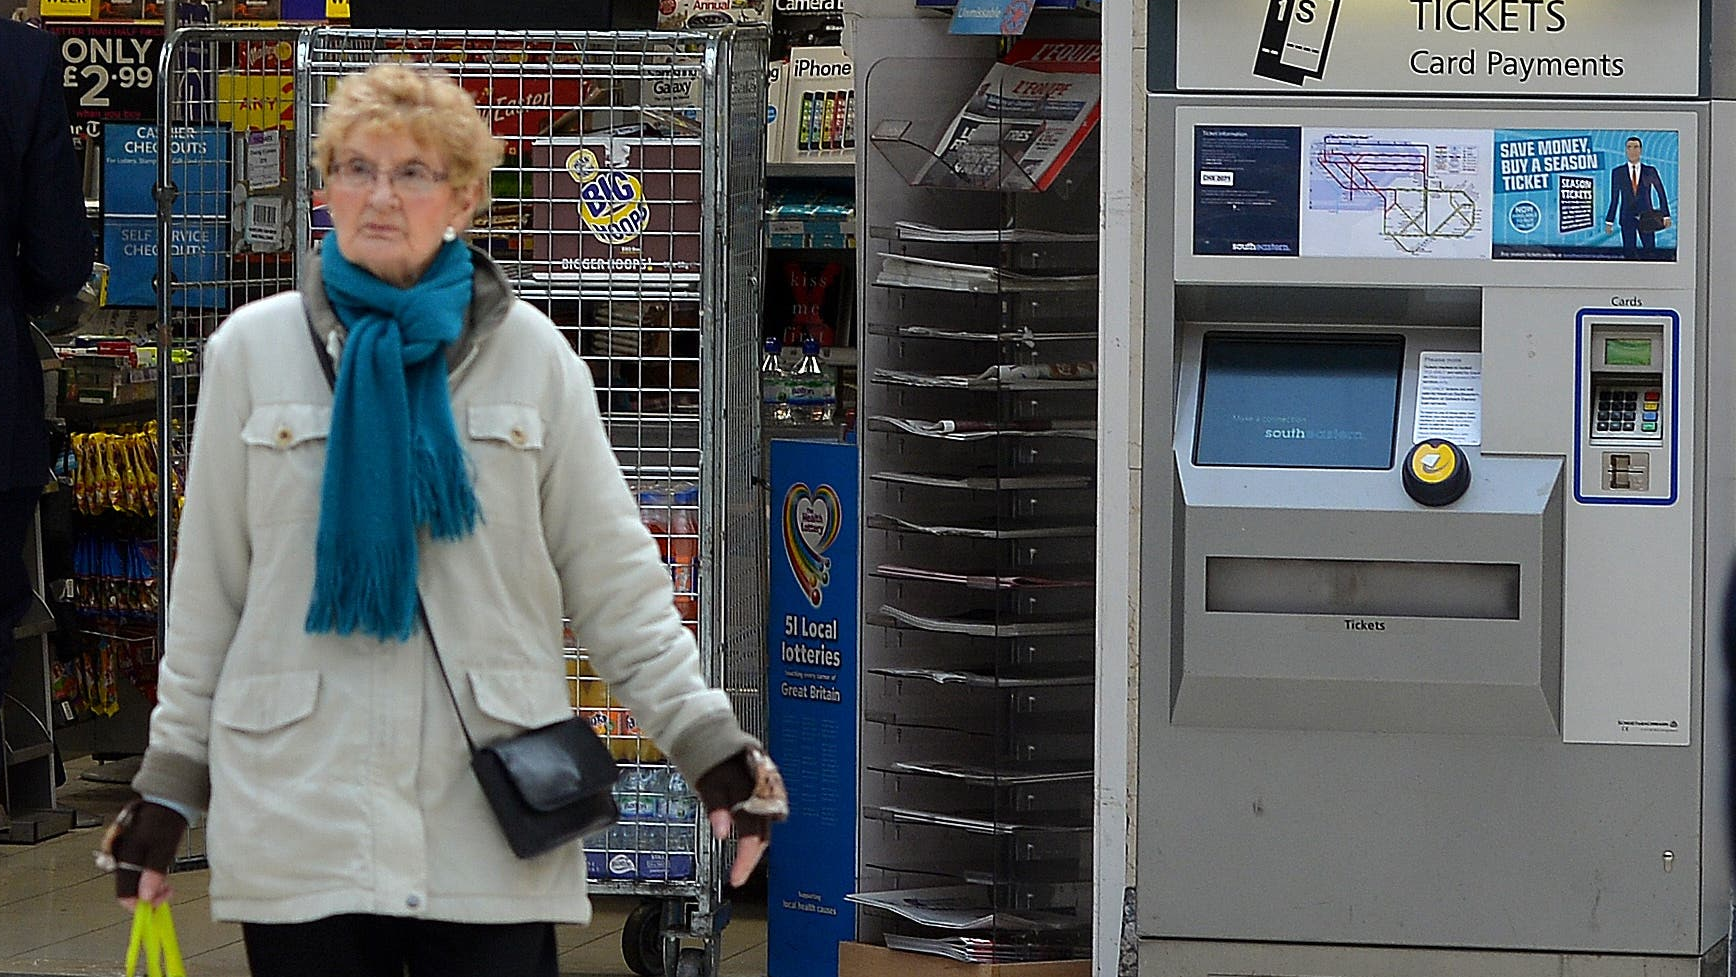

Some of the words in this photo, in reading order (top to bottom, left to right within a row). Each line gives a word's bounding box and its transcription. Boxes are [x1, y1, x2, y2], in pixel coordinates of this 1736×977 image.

[693, 0, 731, 11] Annual
[62, 37, 153, 65] ONLY
[794, 59, 852, 77] iPhone
[1409, 49, 1476, 77] Card
[1487, 50, 1625, 83] Payments
[654, 80, 692, 96] Gaaxy
[136, 127, 195, 140] CAIER
[125, 141, 207, 154] CHECOUTS
[1500, 141, 1535, 158] SAVE
[1538, 137, 1591, 155] MONEY,
[1501, 158, 1528, 174] BUY
[1531, 158, 1541, 172] A
[1544, 154, 1598, 171] SEASON
[1502, 174, 1549, 190] TICKET
[581, 171, 634, 218] BIG
[122, 229, 152, 242] SELF
[124, 244, 206, 257] CHECOUTS
[790, 272, 827, 287] kiss
[1611, 296, 1642, 308] Cards
[783, 326, 825, 343] firt
[802, 616, 837, 641] Local
[1344, 619, 1386, 633] Tickets
[782, 641, 841, 668] lotteries
[781, 682, 808, 699] Great
[810, 684, 841, 703] Britain
